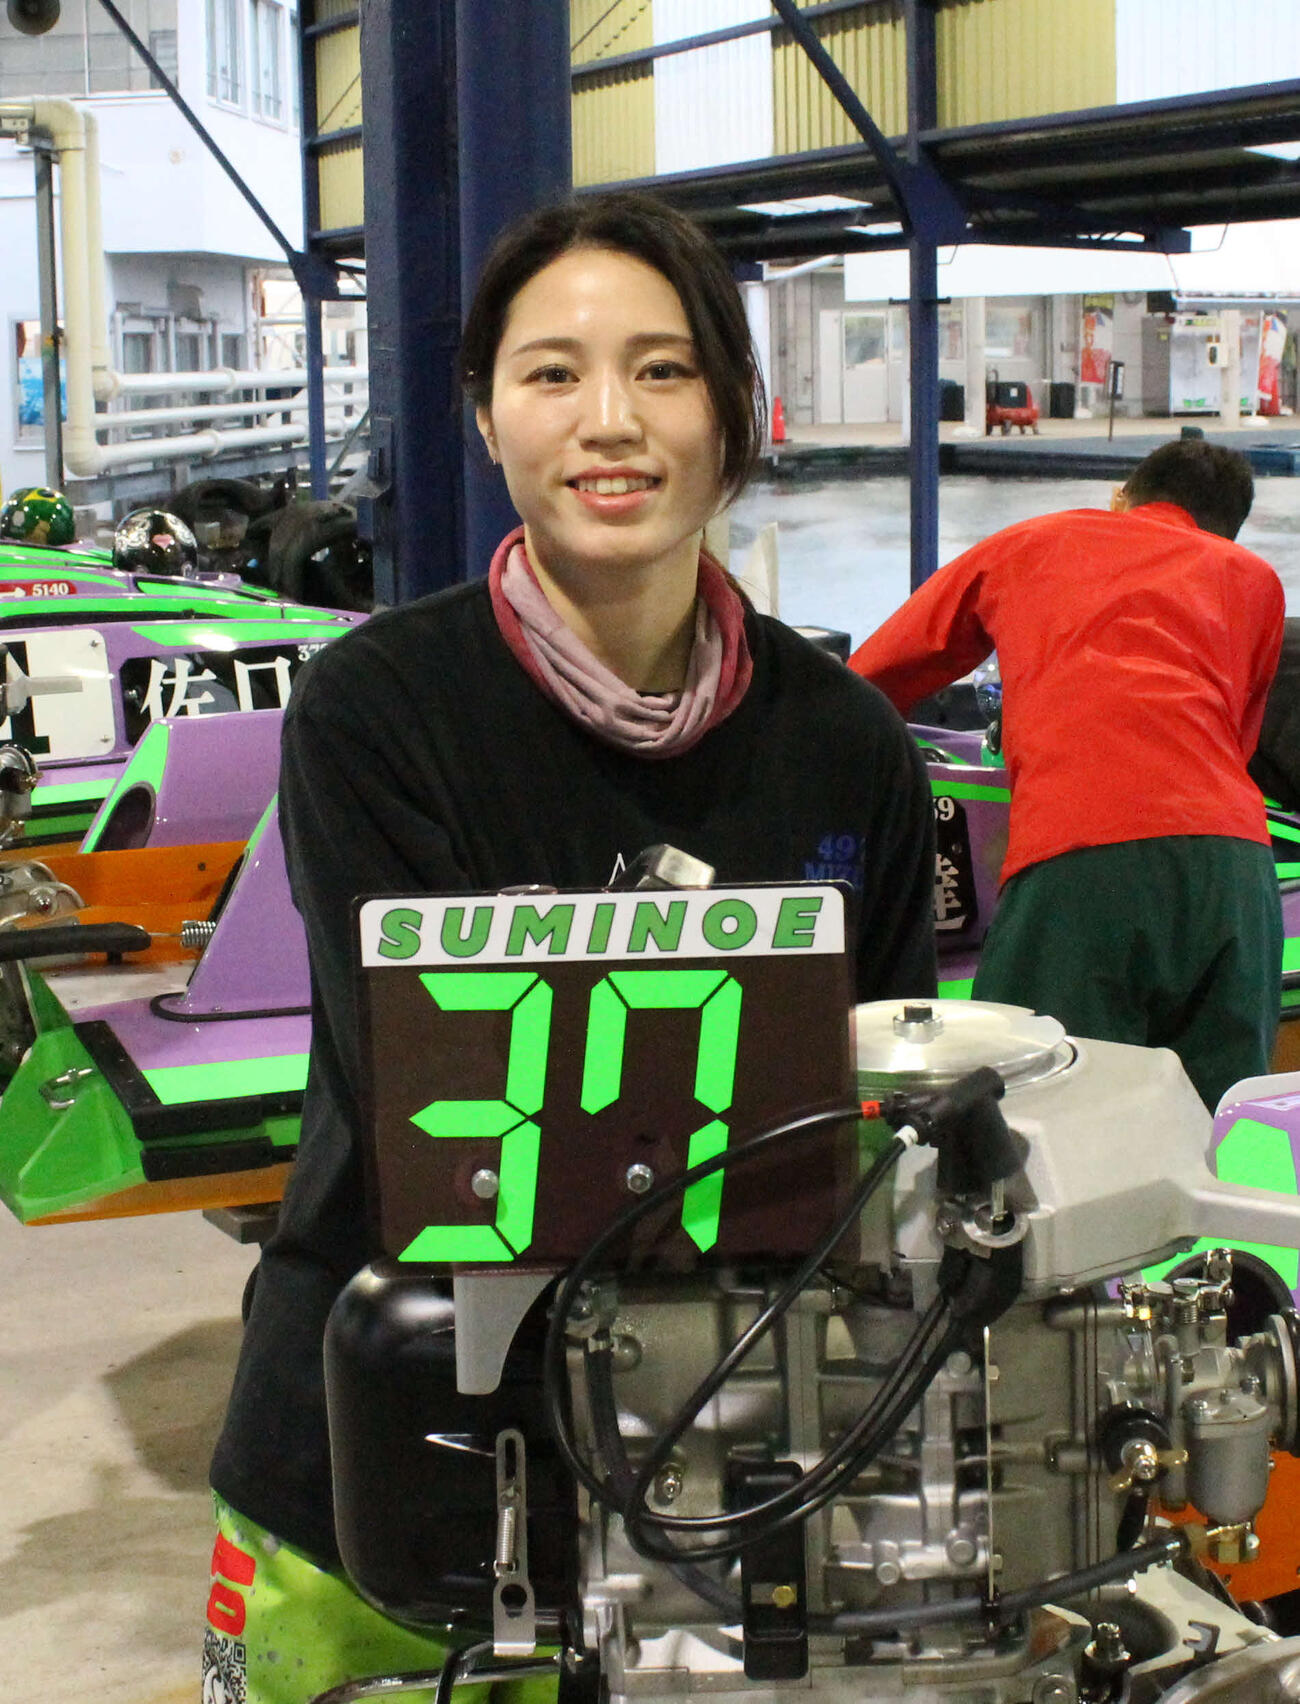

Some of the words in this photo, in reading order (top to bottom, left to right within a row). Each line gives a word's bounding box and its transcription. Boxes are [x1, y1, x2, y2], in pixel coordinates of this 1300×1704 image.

[33, 582, 69, 596] 5140
[377, 896, 823, 961] SUMINOE
[397, 970, 743, 1262] 37
